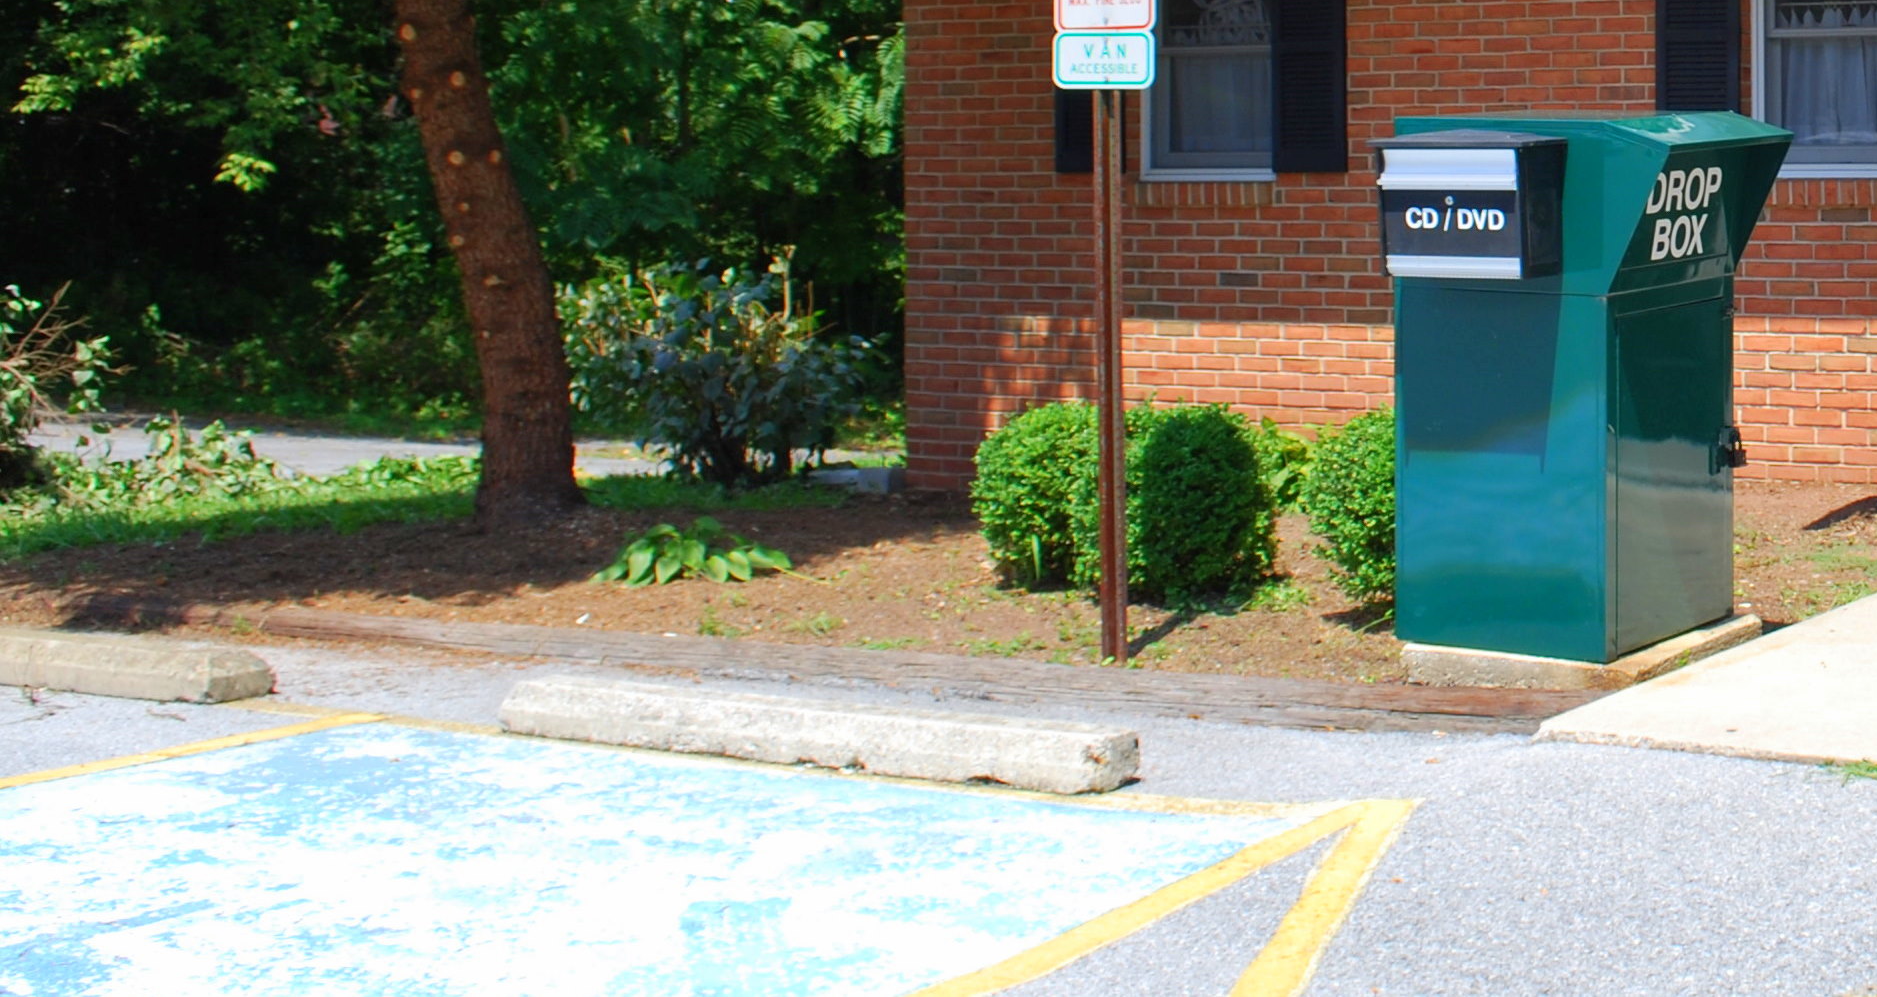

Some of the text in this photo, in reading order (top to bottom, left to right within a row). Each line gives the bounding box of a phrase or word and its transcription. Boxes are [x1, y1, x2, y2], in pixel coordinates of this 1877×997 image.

[1083, 43, 1127, 59] VAN
[1070, 62, 1138, 75] ACCESSIBLE
[1646, 167, 1722, 215] DROP
[1405, 207, 1438, 230] CD
[1457, 208, 1505, 231] DVD
[1650, 214, 1708, 261] BOX
